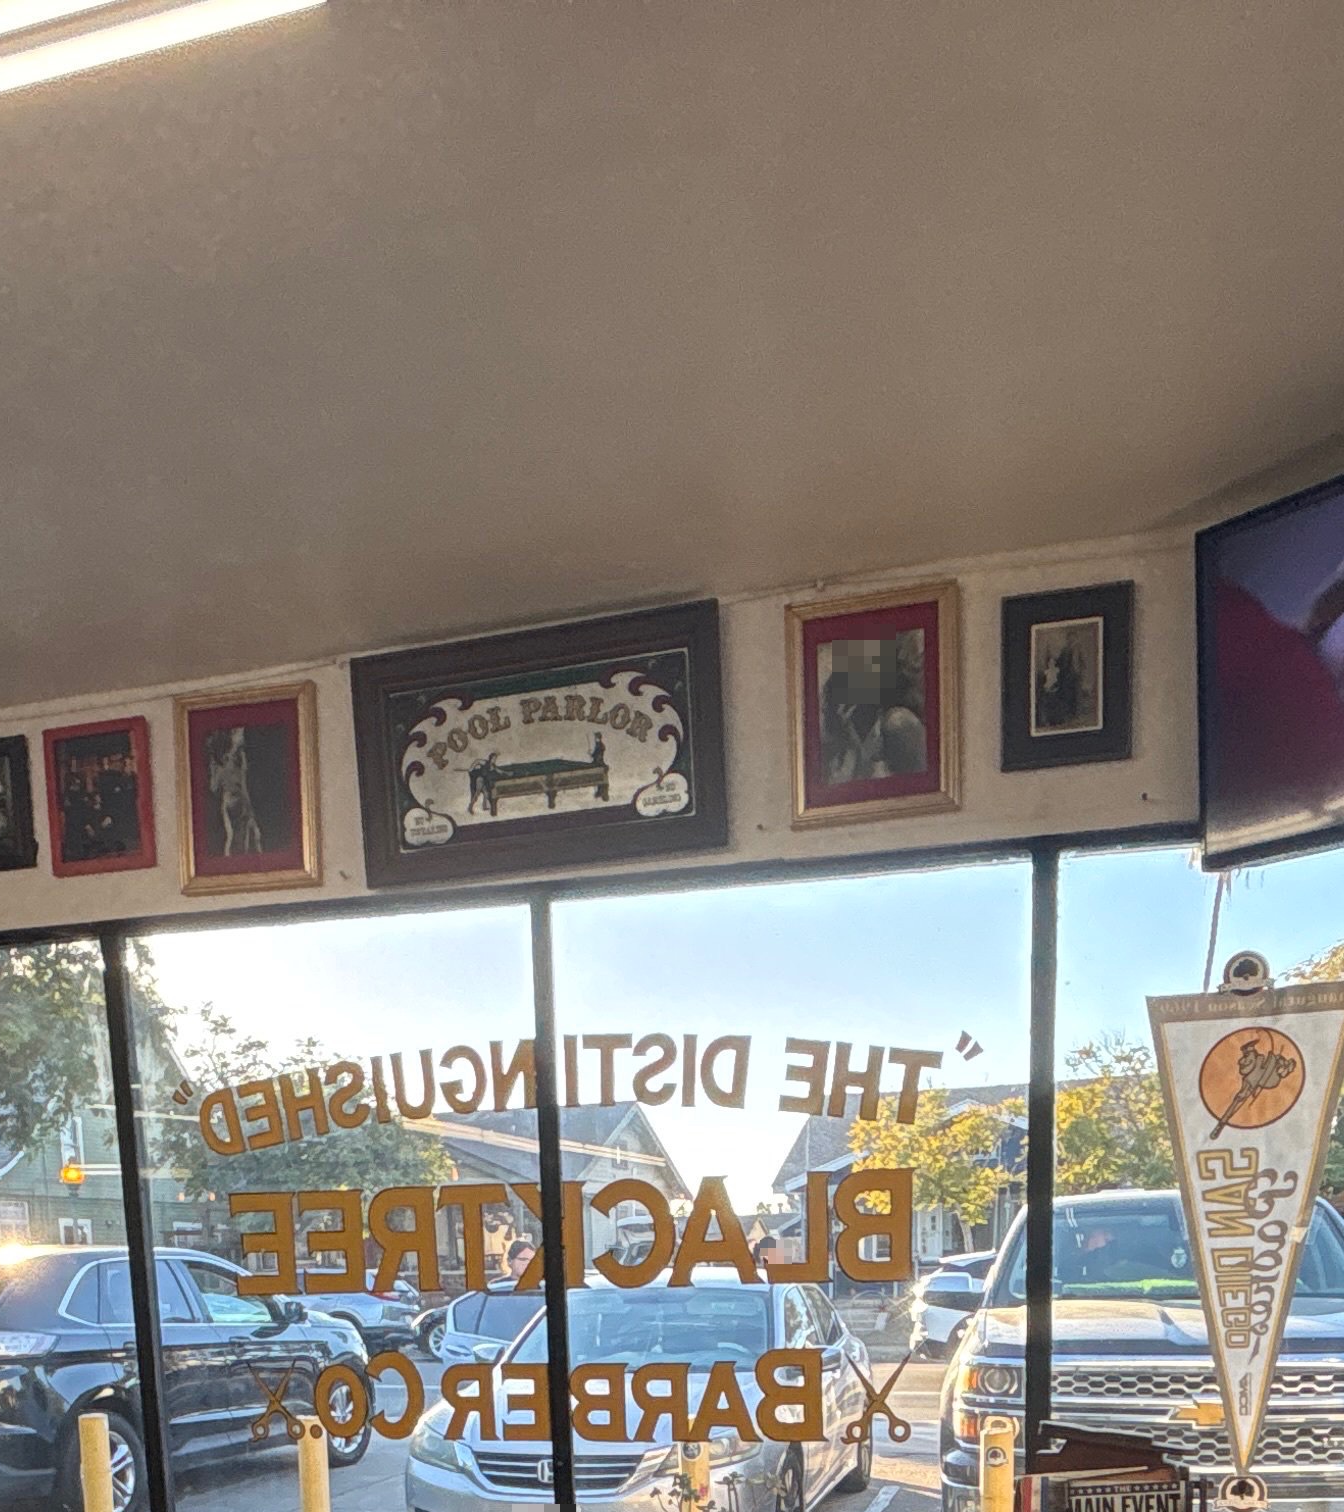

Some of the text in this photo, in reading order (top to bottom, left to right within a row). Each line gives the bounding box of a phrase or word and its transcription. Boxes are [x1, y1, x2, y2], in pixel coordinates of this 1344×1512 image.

[427, 694, 654, 770] POOL PARLOR
[1114, 1484, 1132, 1492] THE
